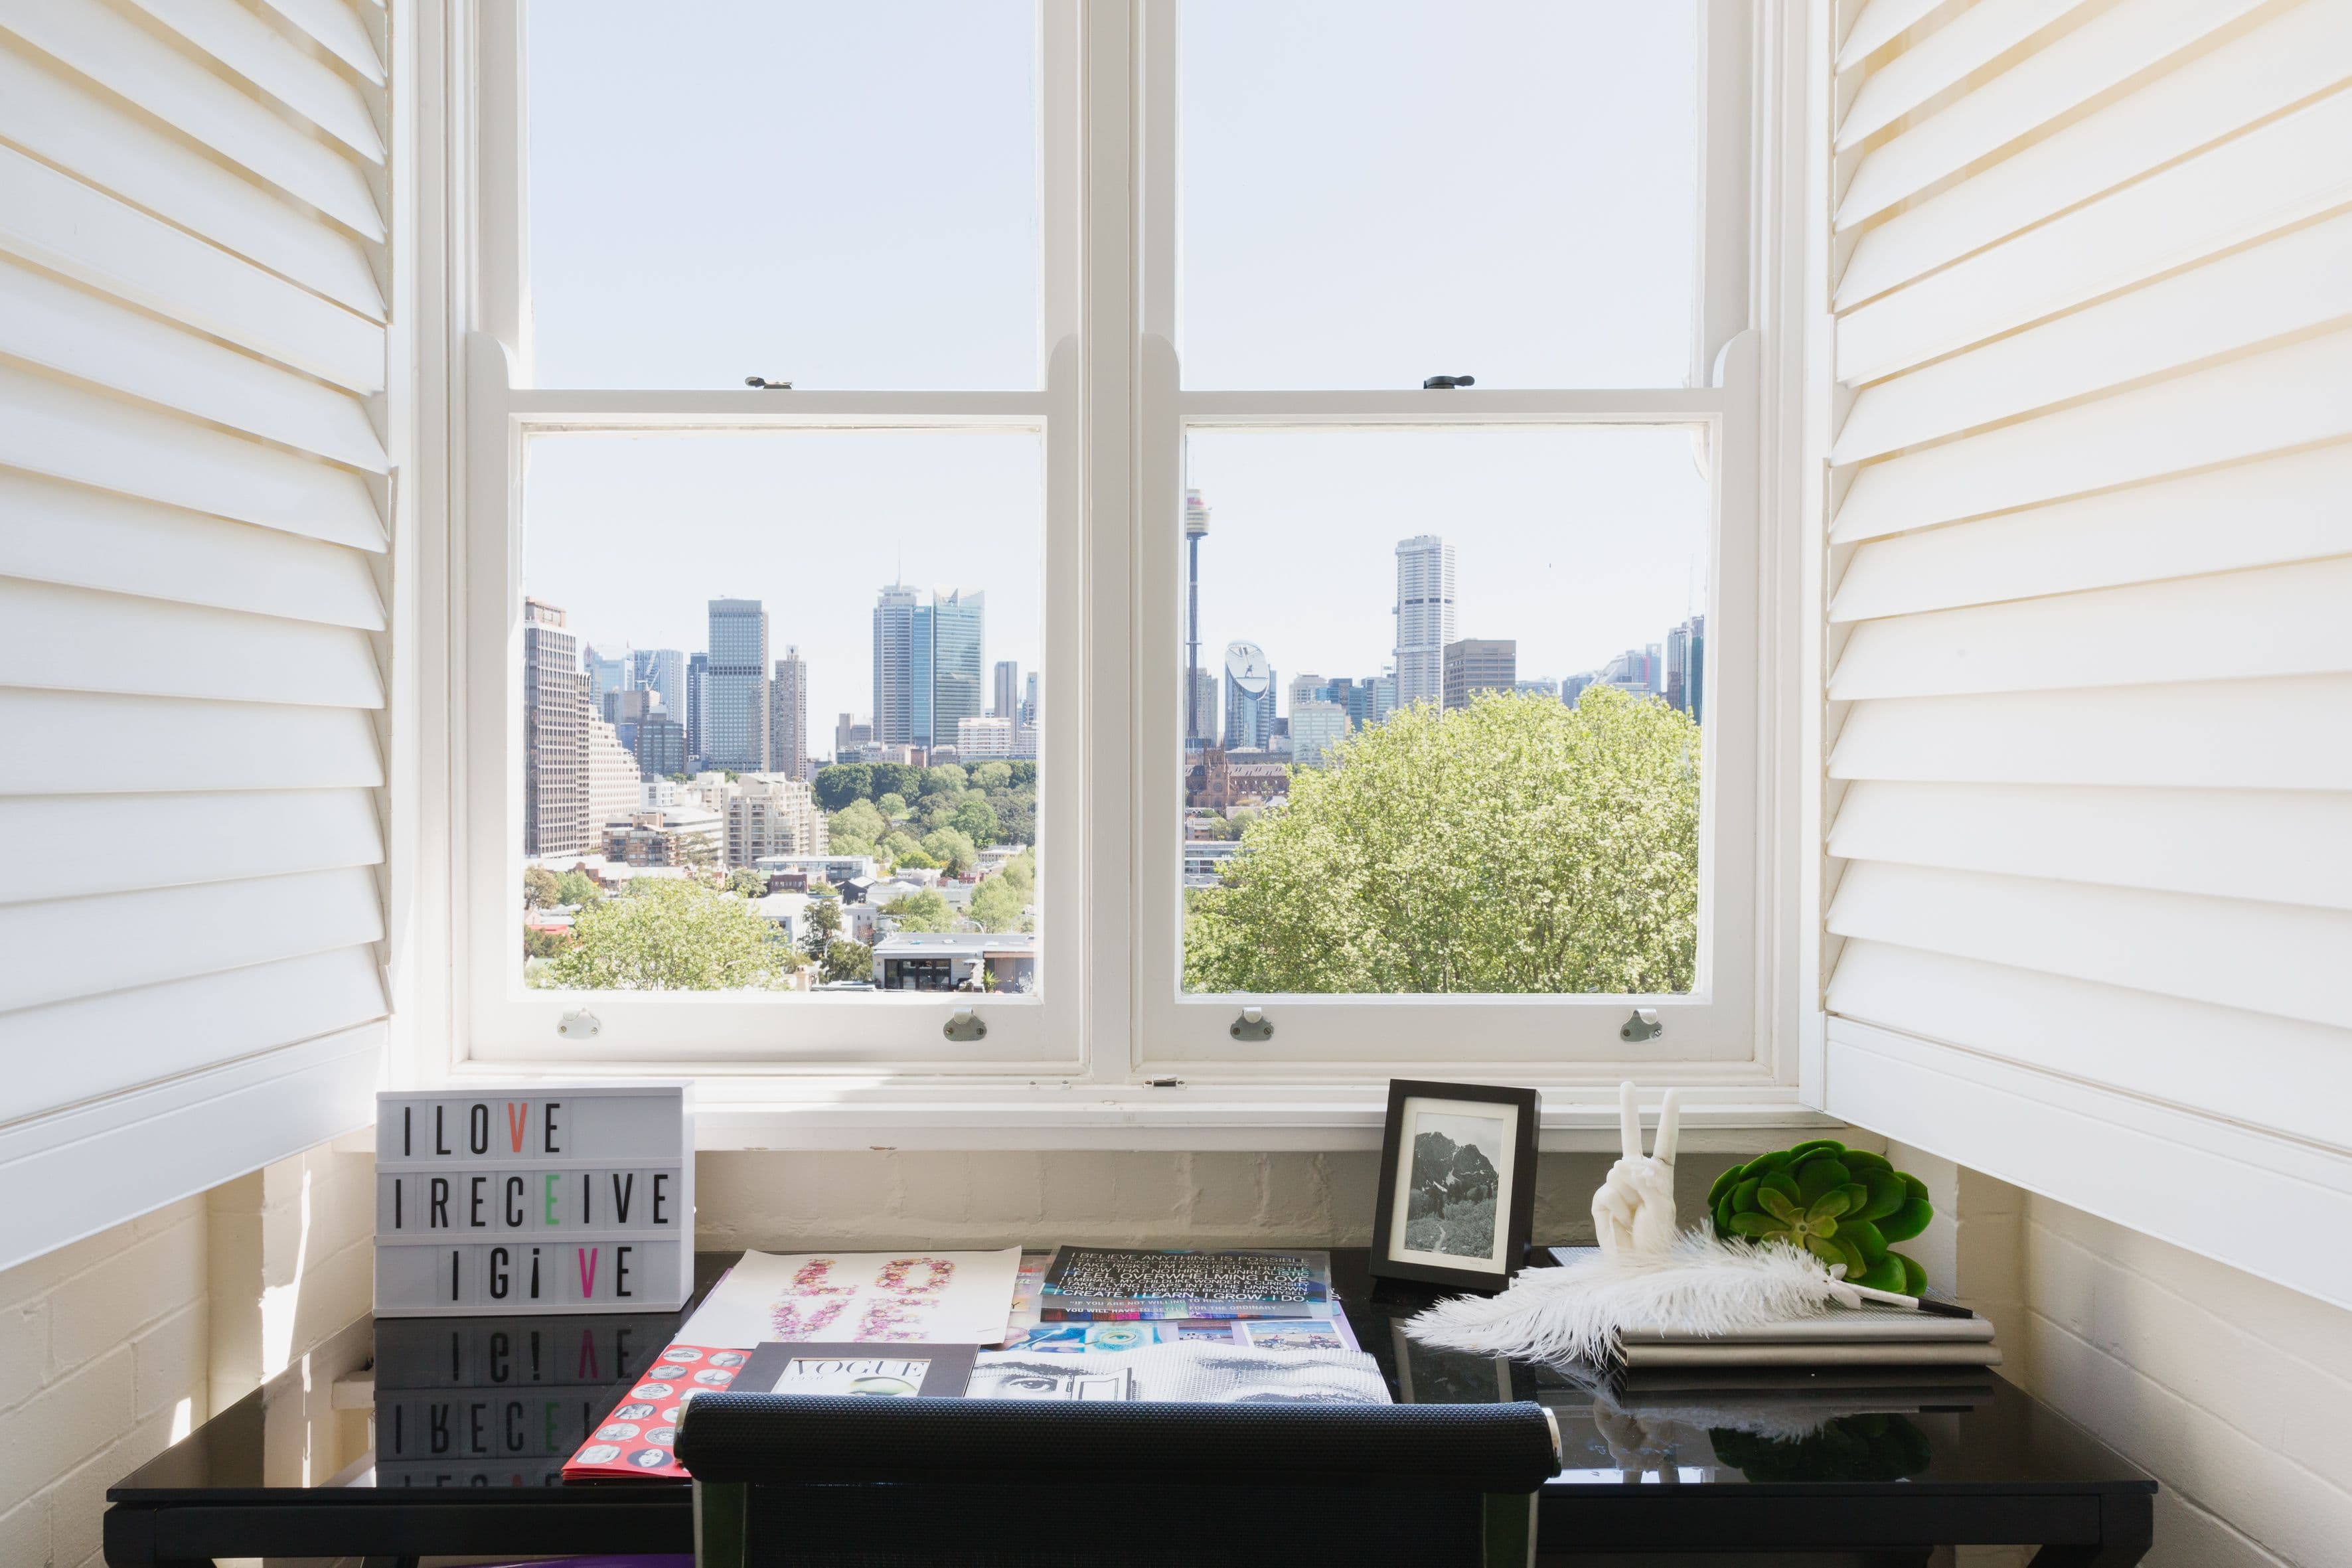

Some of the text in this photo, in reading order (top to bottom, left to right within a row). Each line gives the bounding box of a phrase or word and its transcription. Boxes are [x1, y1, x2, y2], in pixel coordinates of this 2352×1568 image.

[404, 1103, 560, 1156] I LOVE
[396, 1173, 668, 1229] I RECEIVE
[452, 1251, 459, 1300] I
[1120, 1273, 1259, 1281] OVERWHELMING
[1264, 1275, 1309, 1283] LOVE
[1063, 1289, 1127, 1298] CREATE.
[796, 1360, 925, 1376] VOGUE
